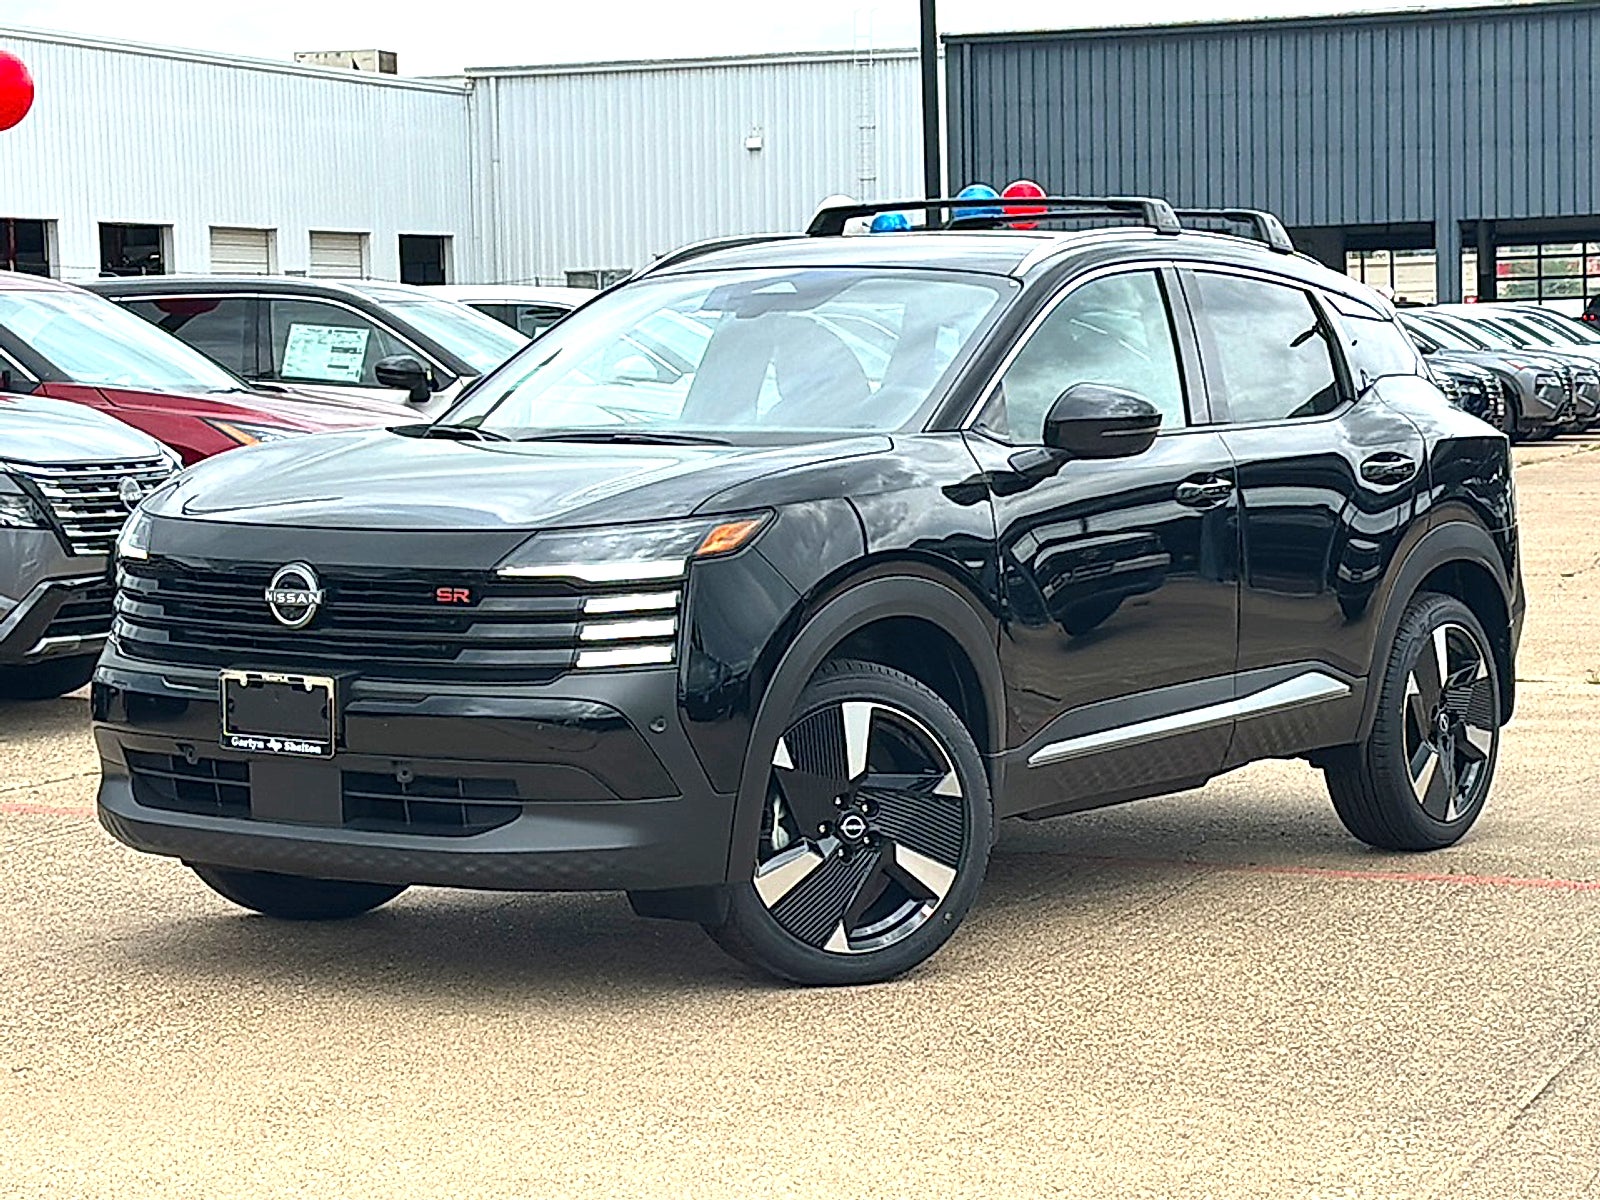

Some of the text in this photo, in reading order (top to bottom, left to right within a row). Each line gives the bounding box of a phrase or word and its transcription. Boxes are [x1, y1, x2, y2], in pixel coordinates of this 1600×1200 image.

[264, 590, 322, 604] NISSAN
[436, 587, 470, 603] SR
[284, 741, 322, 754] Shelton
